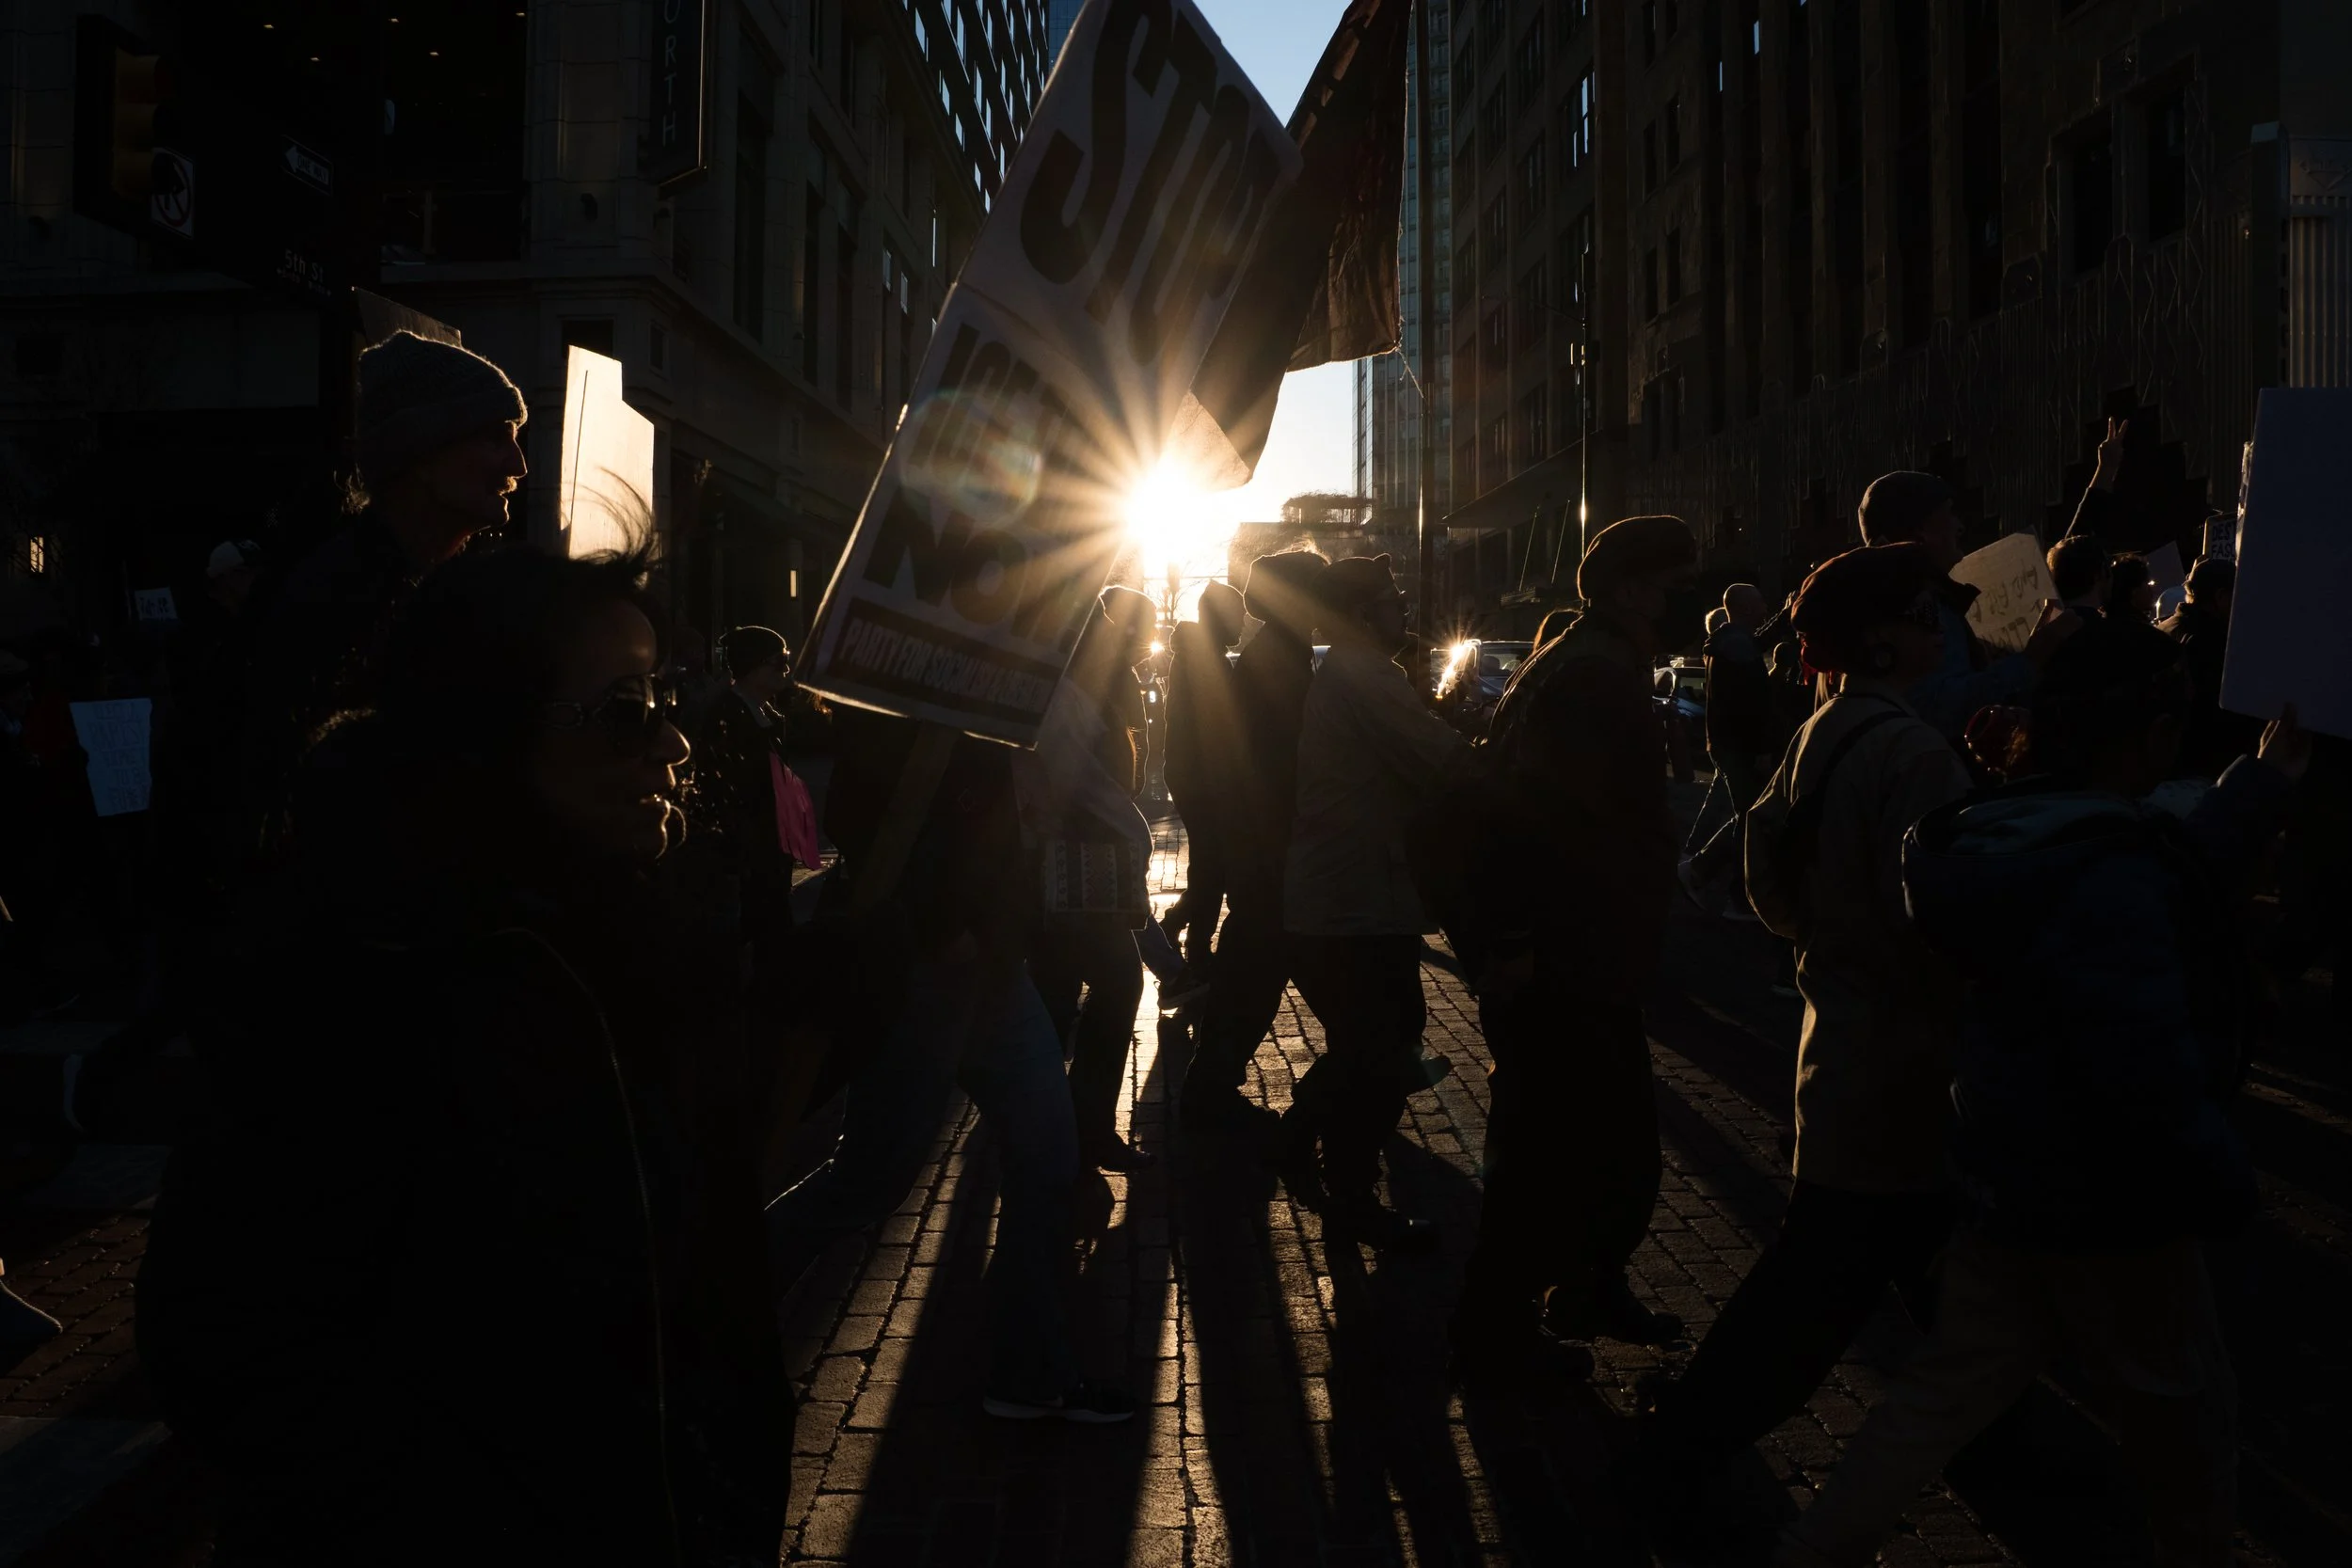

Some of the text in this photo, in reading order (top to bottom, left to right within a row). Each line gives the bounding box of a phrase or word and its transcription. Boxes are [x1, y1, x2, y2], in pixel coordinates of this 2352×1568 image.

[297, 153, 310, 174] ONE
[1021, 0, 1281, 365] STOP
[284, 247, 306, 275] 5th
[310, 261, 325, 284] St
[838, 619, 903, 673] PARTY
[890, 634, 936, 683] FOR
